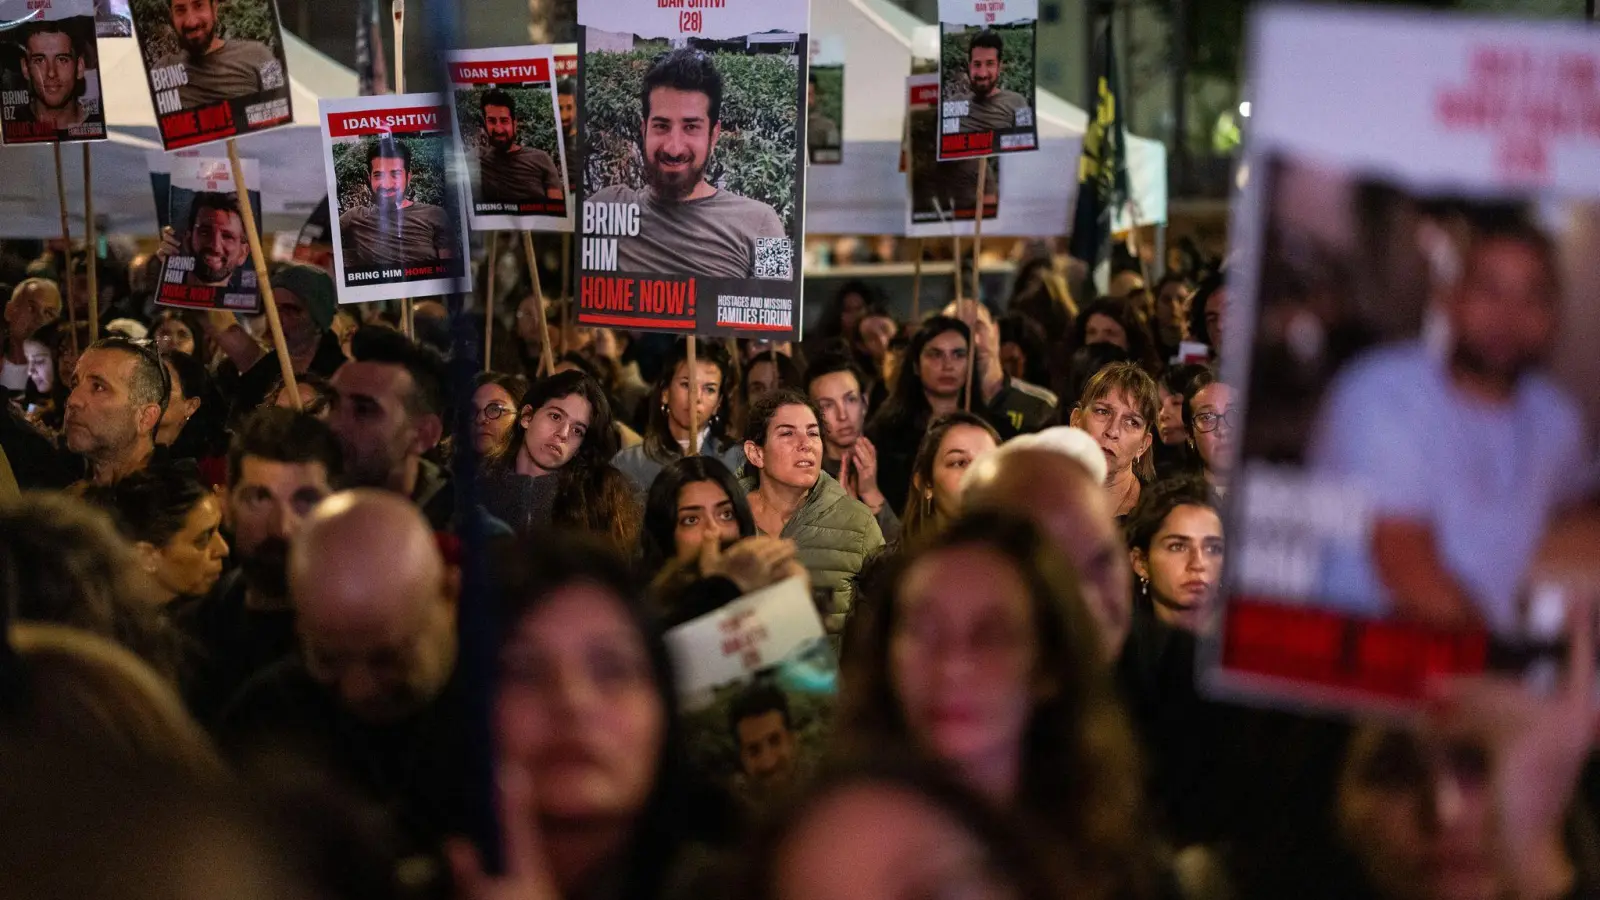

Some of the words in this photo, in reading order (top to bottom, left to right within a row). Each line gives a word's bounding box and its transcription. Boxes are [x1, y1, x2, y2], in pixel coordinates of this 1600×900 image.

[679, 10, 703, 33] (28)
[150, 63, 189, 92] BRING
[460, 67, 489, 79] IDAN
[492, 65, 538, 78] SHTIVI
[2, 90, 30, 105] BRING
[156, 89, 183, 115] HIM
[343, 116, 381, 130] IDAN
[385, 113, 437, 127] SHTIVI
[476, 203, 502, 212] BRING
[504, 204, 519, 212] HIM
[582, 201, 640, 237] BRING
[166, 256, 196, 271] BRING
[581, 237, 618, 271] HIM
[347, 271, 380, 281] BRING
[382, 269, 402, 279] HIM
[404, 266, 434, 276] HOME
[580, 275, 634, 311] HOME
[639, 277, 696, 316] NOW!
[717, 294, 750, 308] HOSTAGES
[750, 297, 763, 309] AND
[763, 297, 793, 311] MISSING
[717, 306, 758, 325] FAMILIES
[759, 308, 792, 327] FORUM
